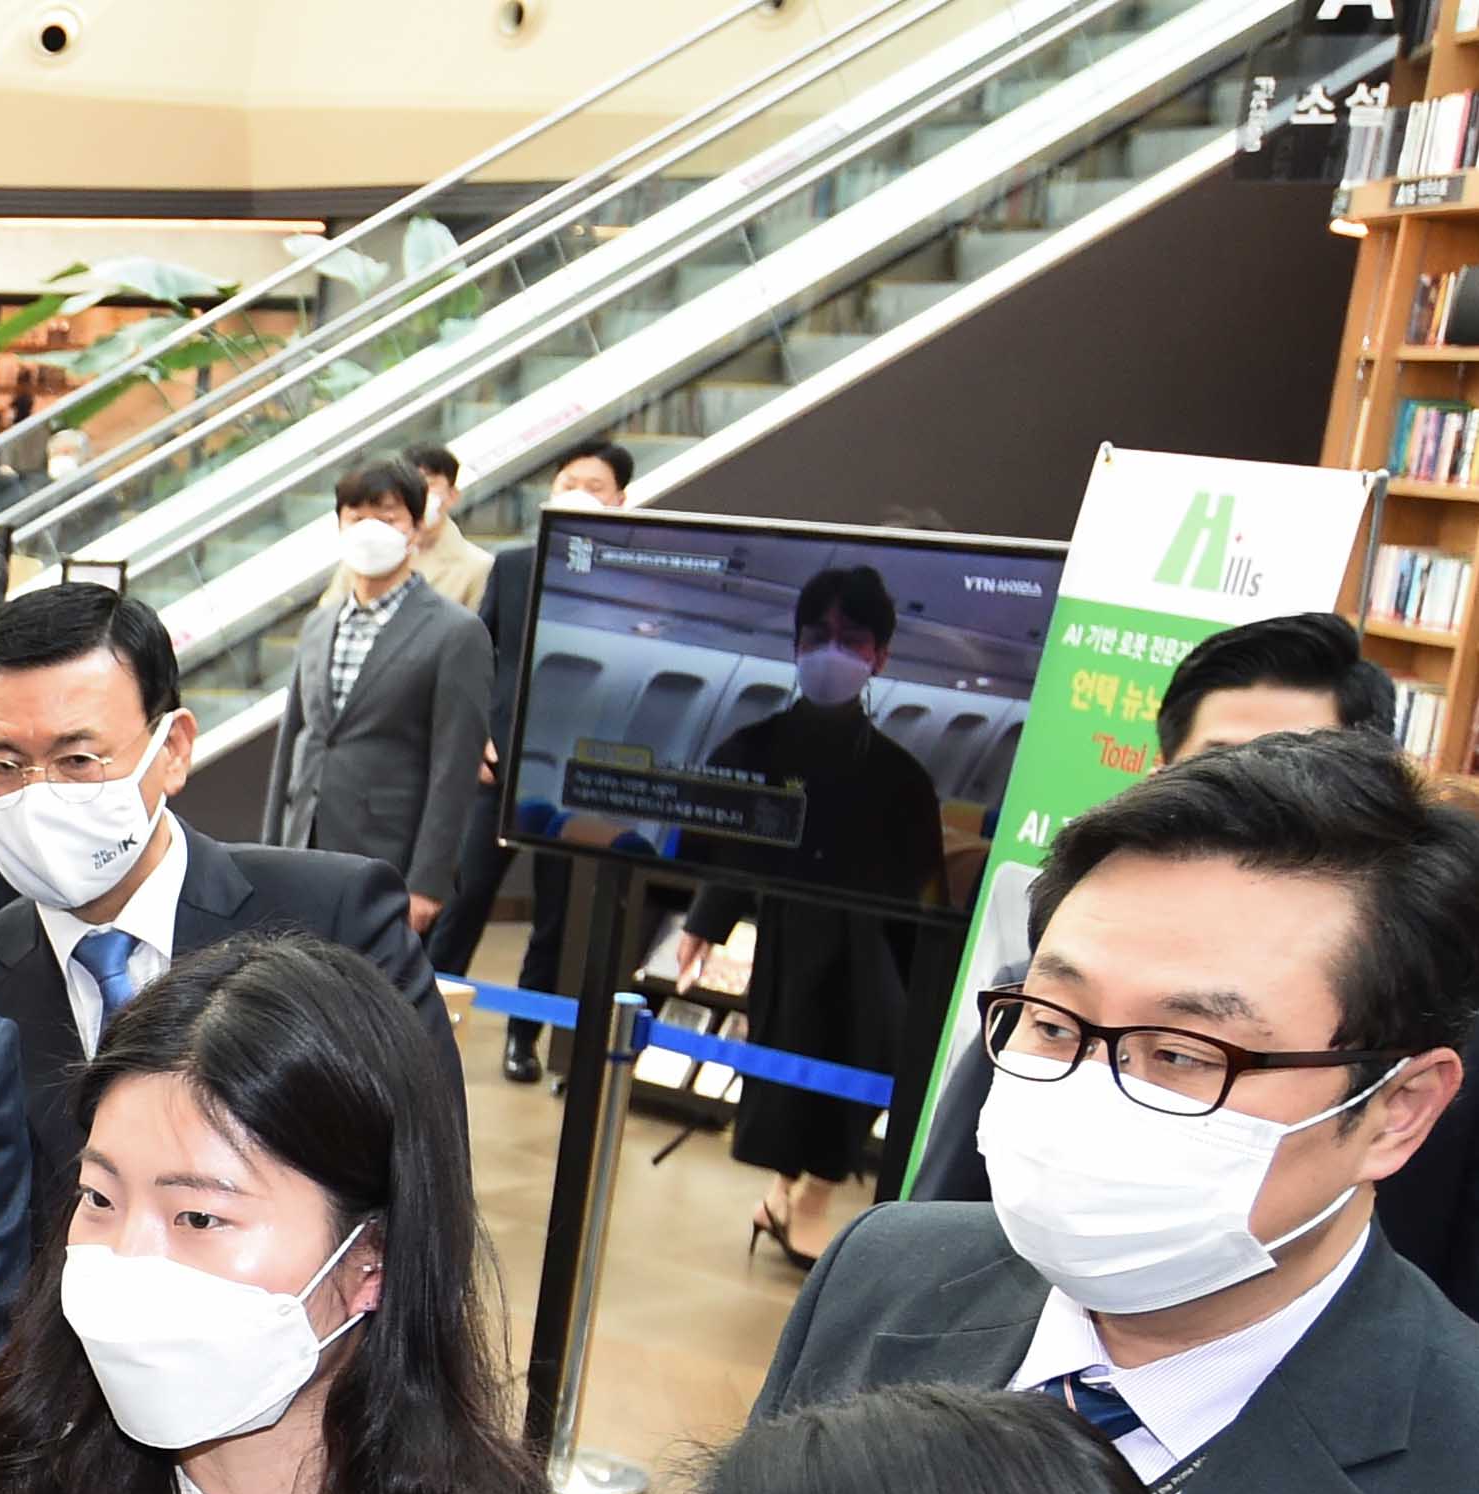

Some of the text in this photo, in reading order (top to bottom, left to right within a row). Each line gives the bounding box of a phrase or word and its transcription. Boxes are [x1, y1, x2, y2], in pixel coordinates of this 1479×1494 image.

[1291, 82, 1390, 127] 소설
[964, 576, 995, 592] YTN
[1062, 623, 1083, 647] AI
[1086, 624, 1118, 655] 기반
[1121, 680, 1163, 721] 뉴노
[1017, 810, 1051, 849] AI
